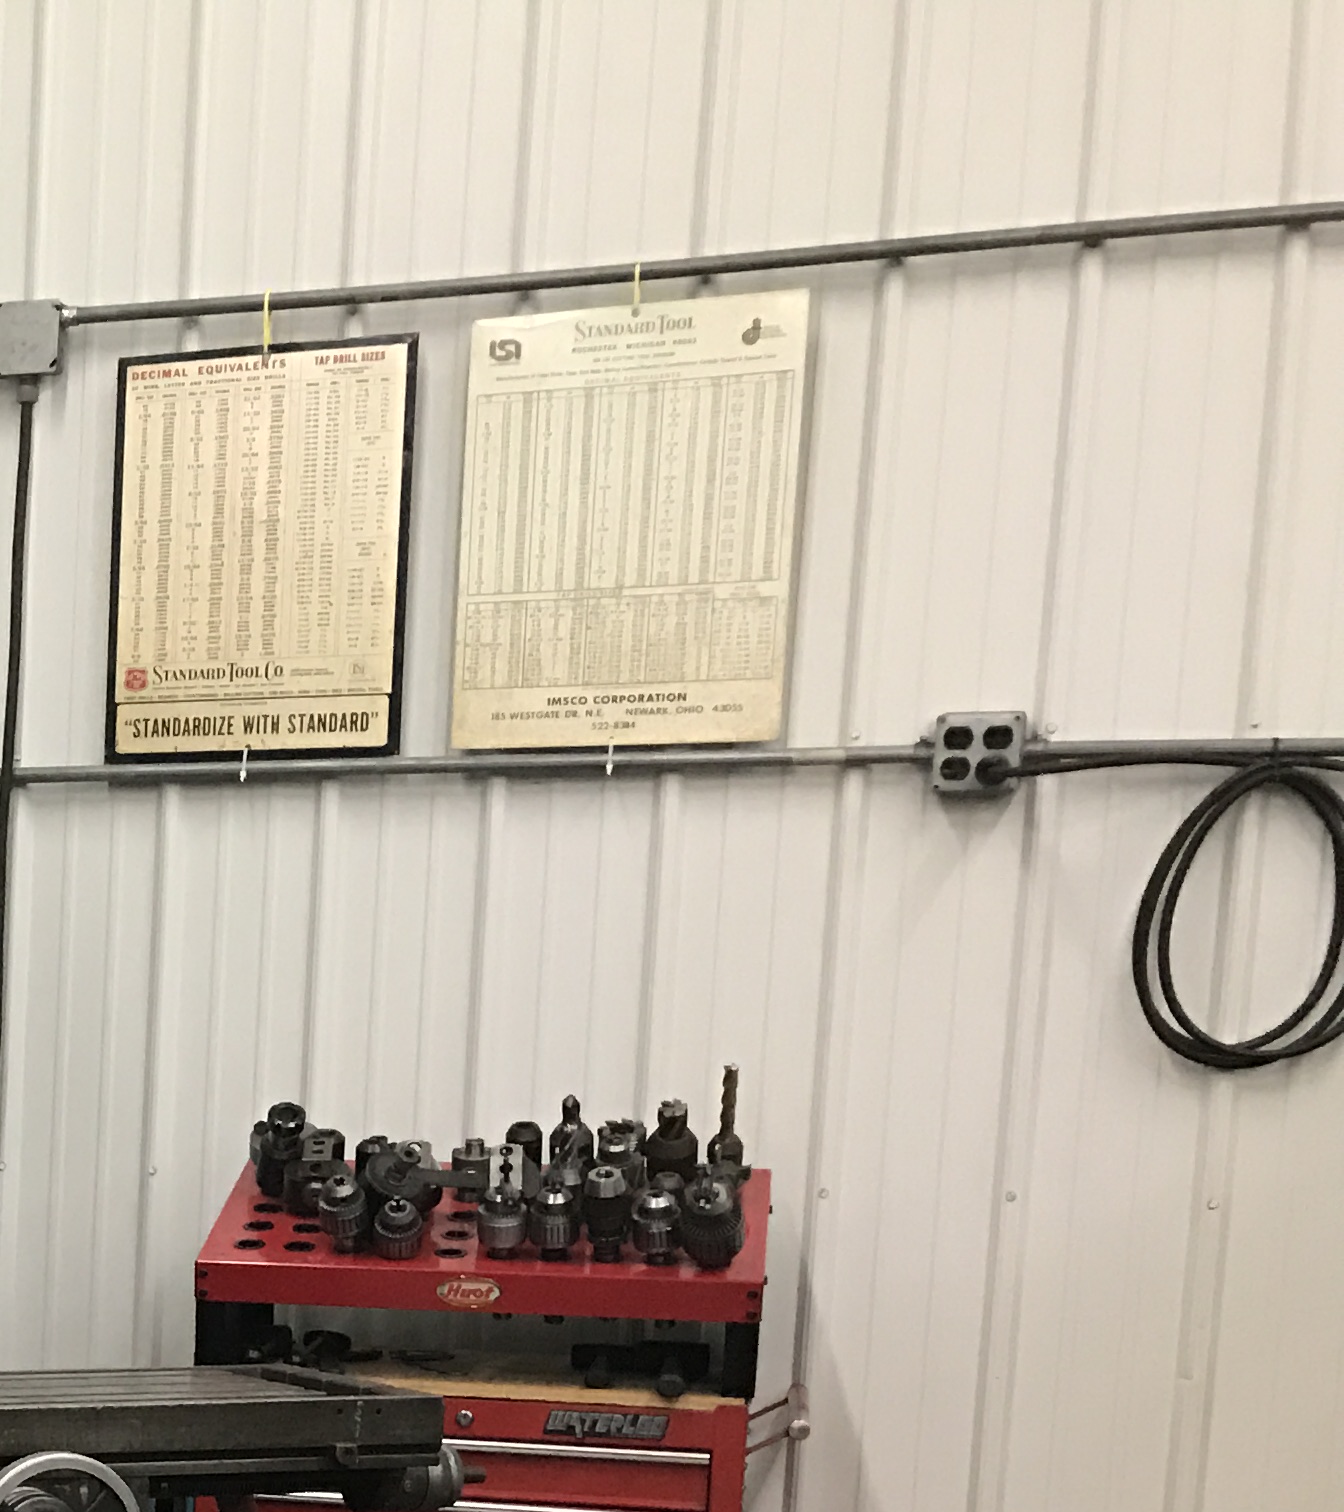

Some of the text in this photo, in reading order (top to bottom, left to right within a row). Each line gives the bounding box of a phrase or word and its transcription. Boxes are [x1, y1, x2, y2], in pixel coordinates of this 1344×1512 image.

[574, 314, 696, 342] STANDARD TOOL
[131, 358, 287, 381] DECIMAL EQUIVALENTS
[314, 350, 386, 366] TAP DRILL SIZES
[152, 664, 226, 686] STANDARD
[227, 661, 262, 682] TOOL
[592, 692, 688, 705] CORPORATION
[509, 709, 560, 721] WESTGATE
[676, 704, 704, 715] OHIO
[242, 713, 280, 736] WITH
[445, 1284, 495, 1300] Huot
[546, 1409, 669, 1438] WATERLOO
